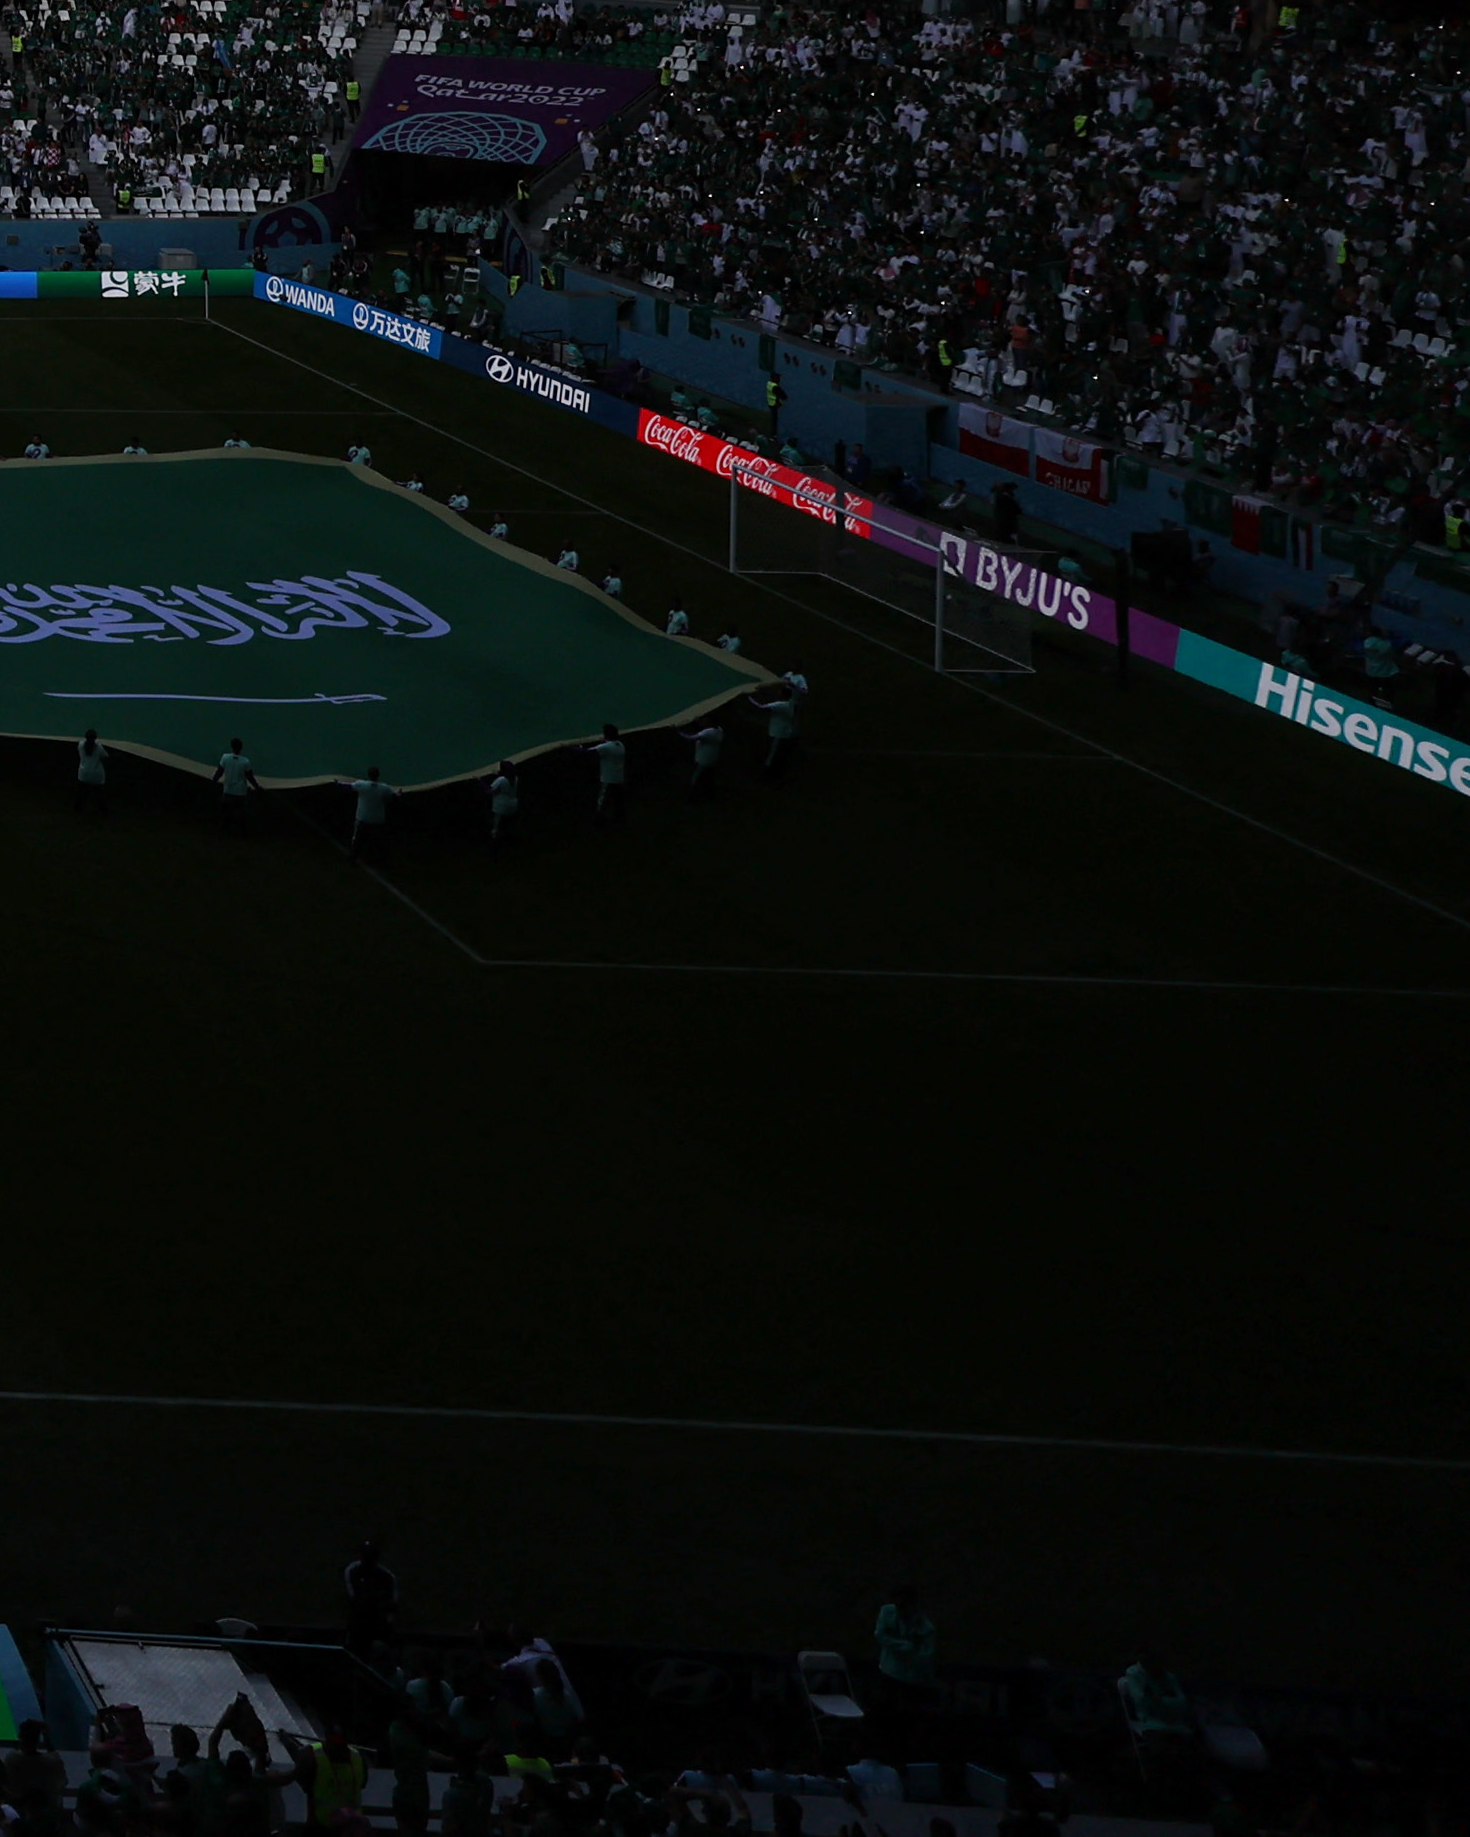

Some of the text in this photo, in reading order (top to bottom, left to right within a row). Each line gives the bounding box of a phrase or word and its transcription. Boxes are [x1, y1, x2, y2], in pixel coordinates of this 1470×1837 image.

[414, 74, 607, 97] FIFA WORLD CUP
[133, 271, 187, 298] 蒙牛
[285, 284, 336, 317] WANDA
[370, 310, 432, 353] 万达文旅
[516, 366, 591, 414] HYUNDAI
[975, 547, 1092, 633] BYJU'S
[1253, 661, 1470, 799] Hisense
